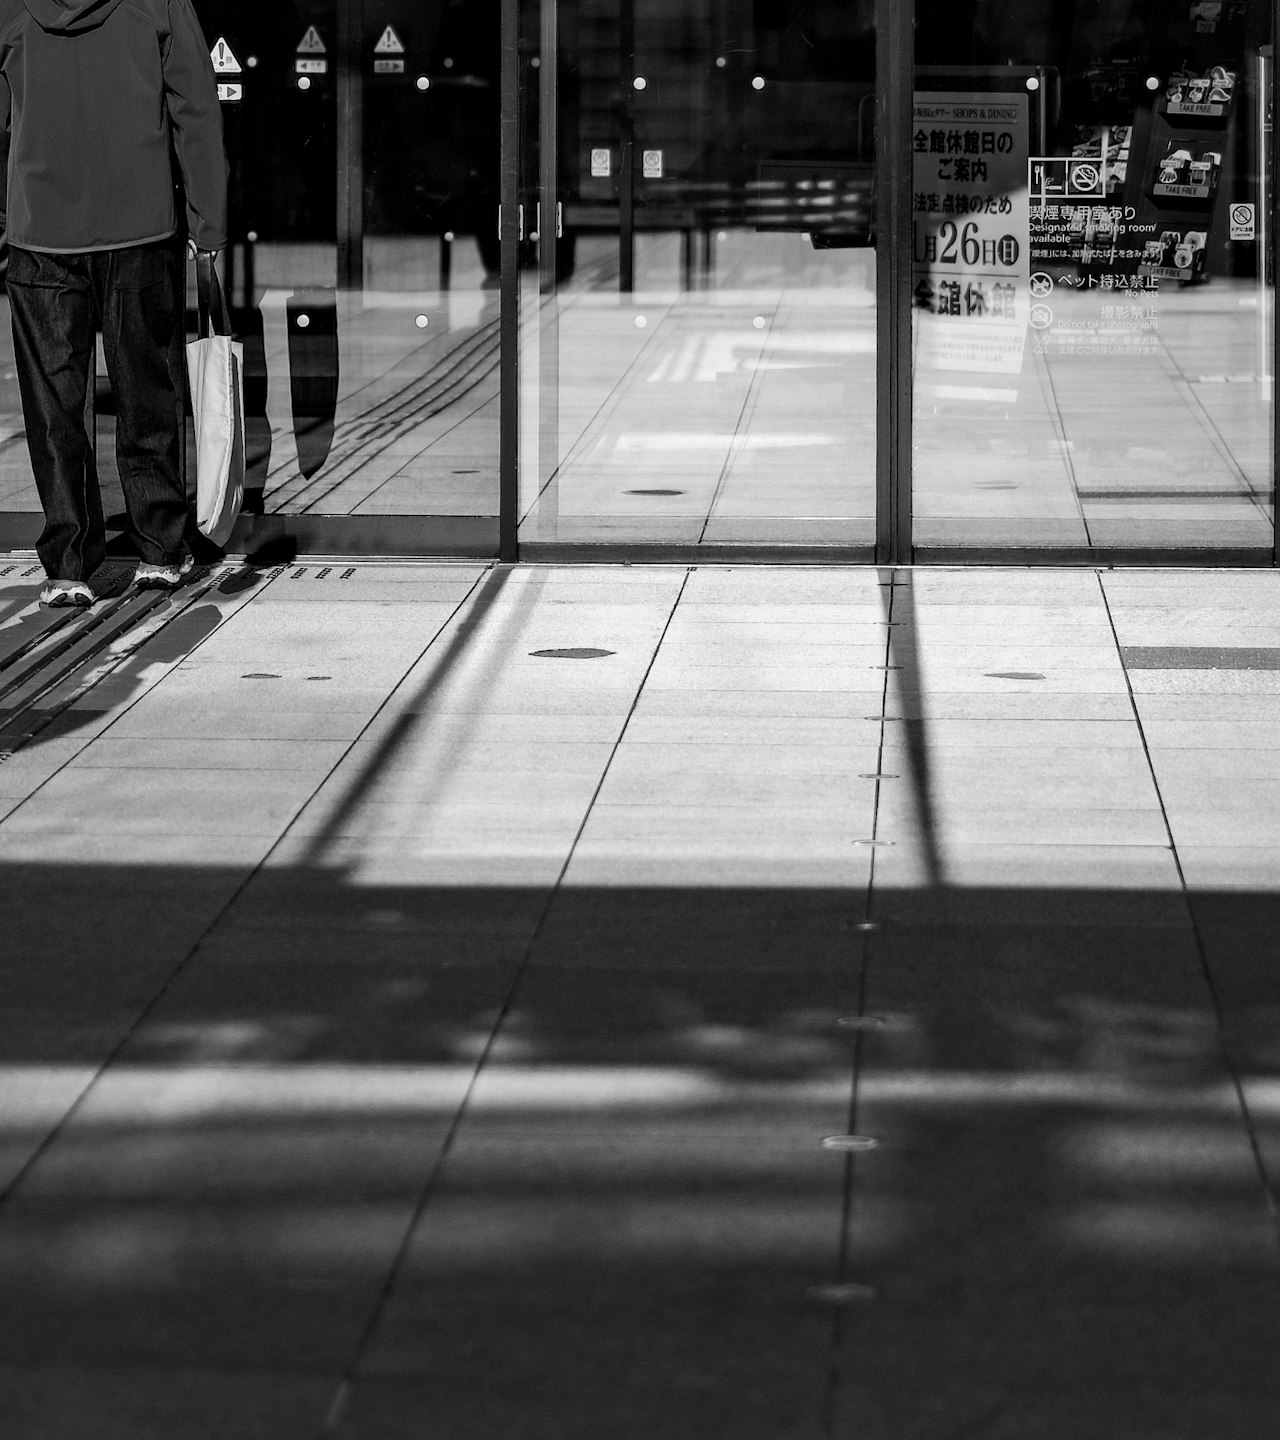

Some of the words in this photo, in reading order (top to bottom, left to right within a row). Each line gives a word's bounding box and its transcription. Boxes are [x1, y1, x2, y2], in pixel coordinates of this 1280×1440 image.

[952, 108, 978, 119] SHOPS
[979, 109, 986, 119] &
[1178, 103, 1195, 113] TAKE
[1195, 103, 1212, 114] FREE
[913, 129, 1013, 155] 全館休館日の
[938, 157, 988, 182] ご案内
[1165, 185, 1181, 195] TAKE
[1181, 186, 1198, 196] FREE
[913, 192, 1013, 215] 法定点検のため
[1028, 205, 1136, 220] 喫煙専用室あり
[1028, 222, 1083, 234] Designated
[1084, 222, 1126, 234] smoking
[1028, 233, 1072, 243] available
[1150, 267, 1165, 276] AKE
[1165, 268, 1181, 278] FREE
[1057, 273, 1159, 288] ペット持込禁止
[913, 279, 1017, 320] 全館休館
[1124, 290, 1138, 298] No
[1140, 290, 1159, 298] Pets
[1100, 305, 1159, 320] 撮影禁止
[1057, 321, 1071, 329] Do
[1073, 321, 1087, 329] not
[1087, 320, 1105, 329] take
[1106, 320, 1159, 330] photographs
